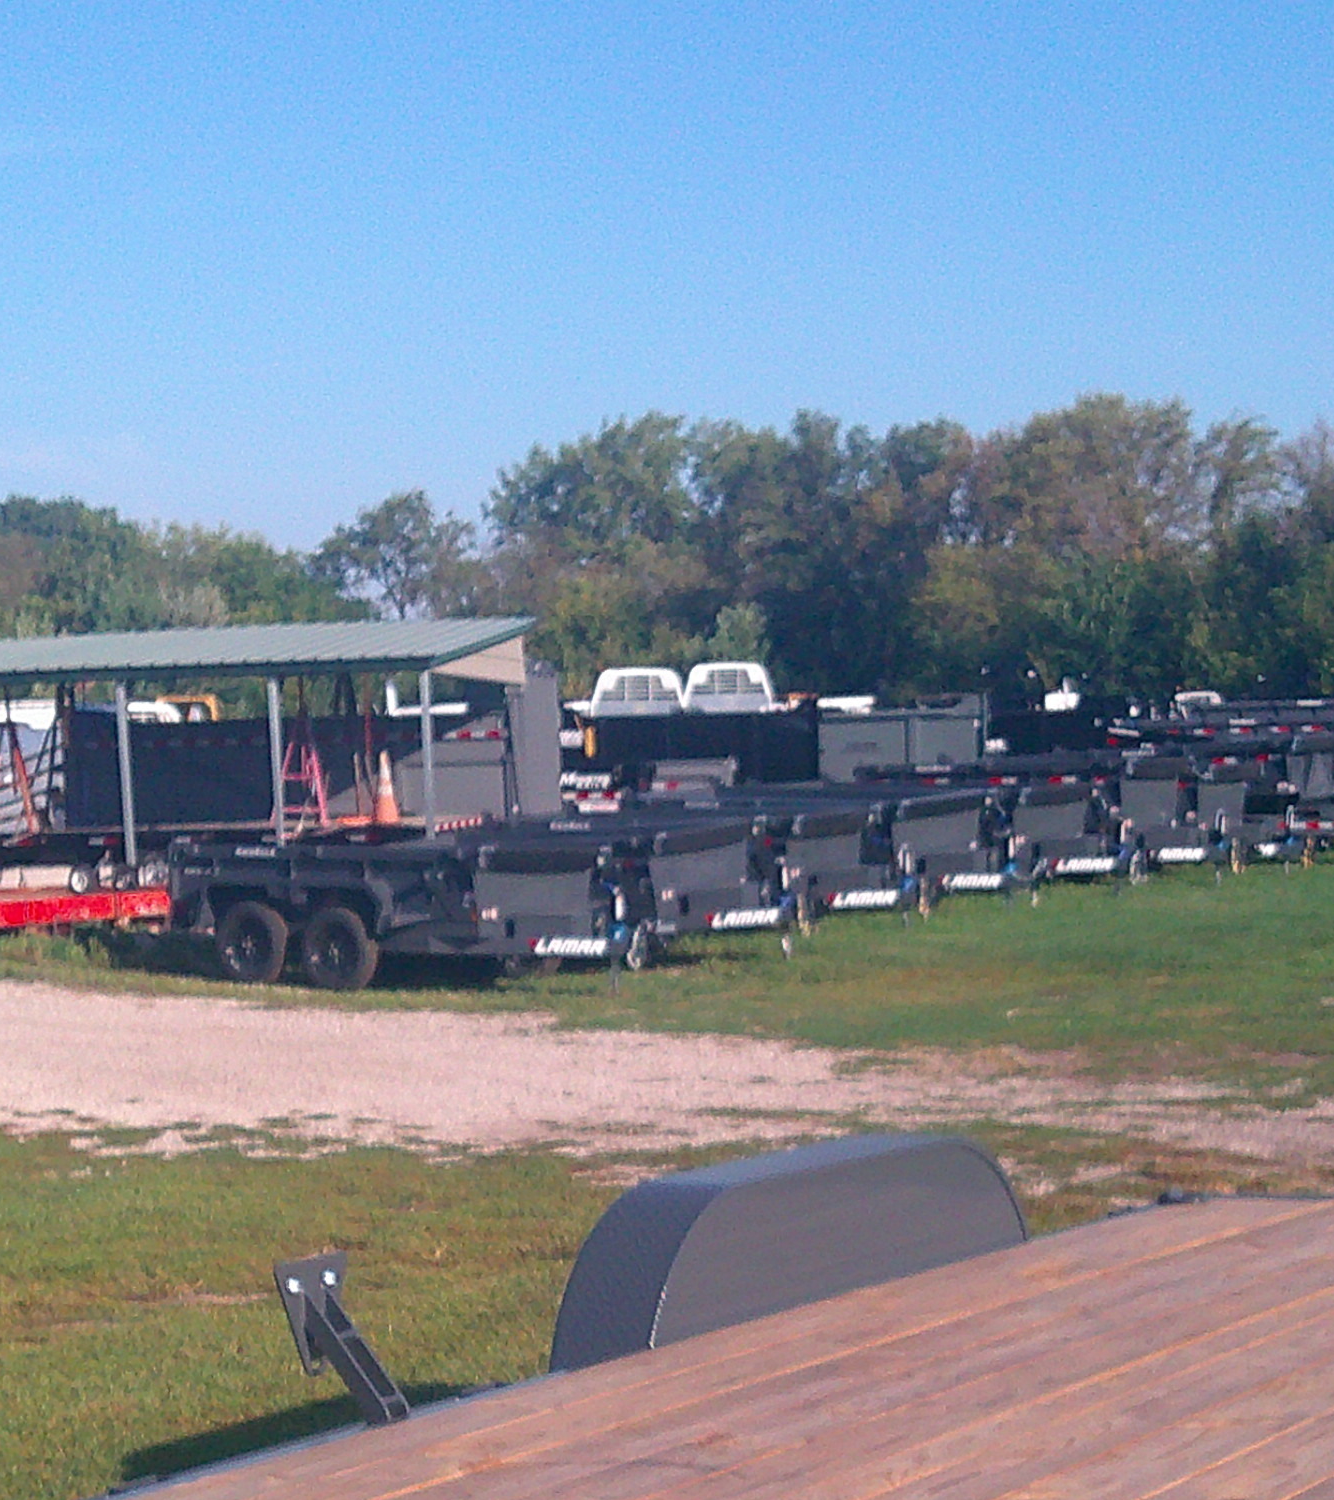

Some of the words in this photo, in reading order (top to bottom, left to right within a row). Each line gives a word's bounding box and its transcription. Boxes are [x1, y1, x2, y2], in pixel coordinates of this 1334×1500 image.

[832, 889, 898, 908] LAMAR
[711, 908, 780, 929] LAMAR
[534, 937, 608, 955] LAMAR
